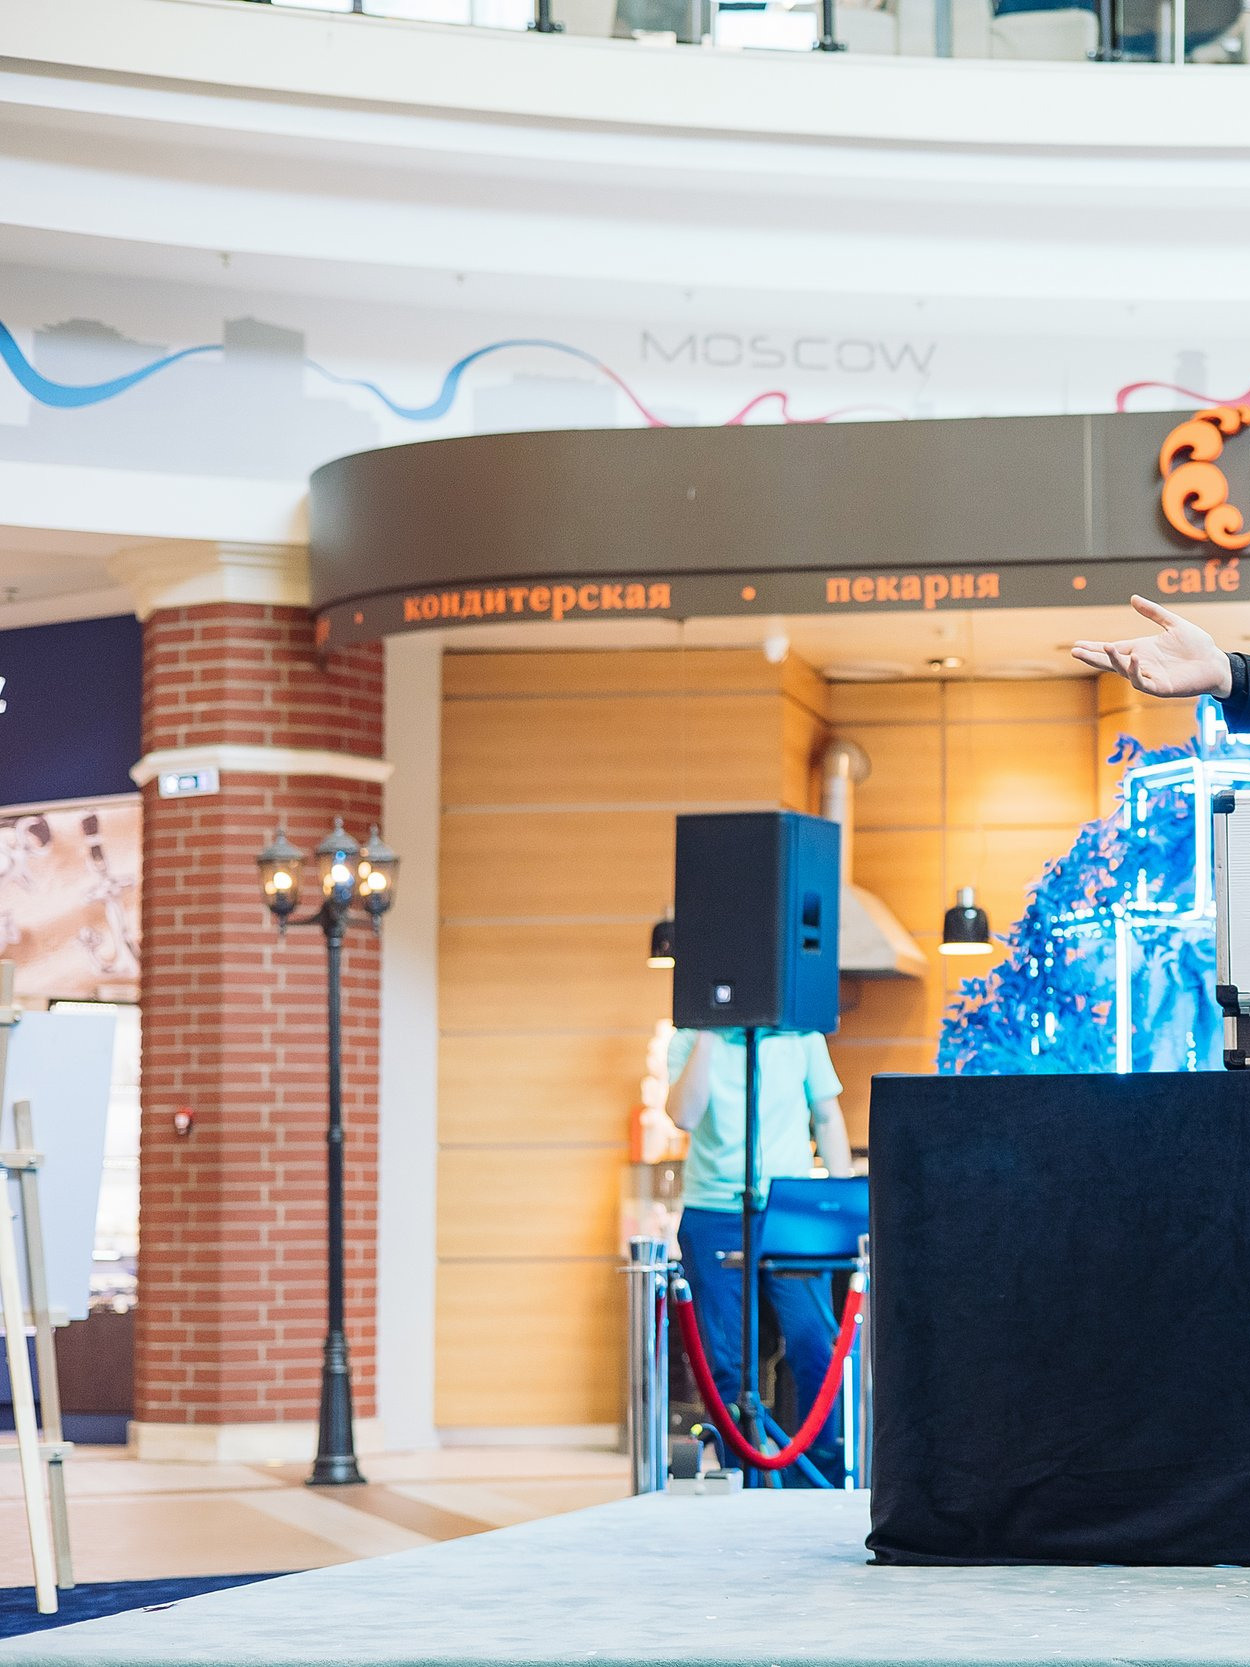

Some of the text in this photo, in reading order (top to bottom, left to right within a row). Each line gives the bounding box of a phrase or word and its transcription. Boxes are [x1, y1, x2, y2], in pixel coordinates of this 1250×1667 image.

[640, 330, 937, 373] MOSCOW
[826, 573, 1000, 608] пекарня
[1157, 558, 1241, 594] café
[404, 583, 672, 622] кондитерская
